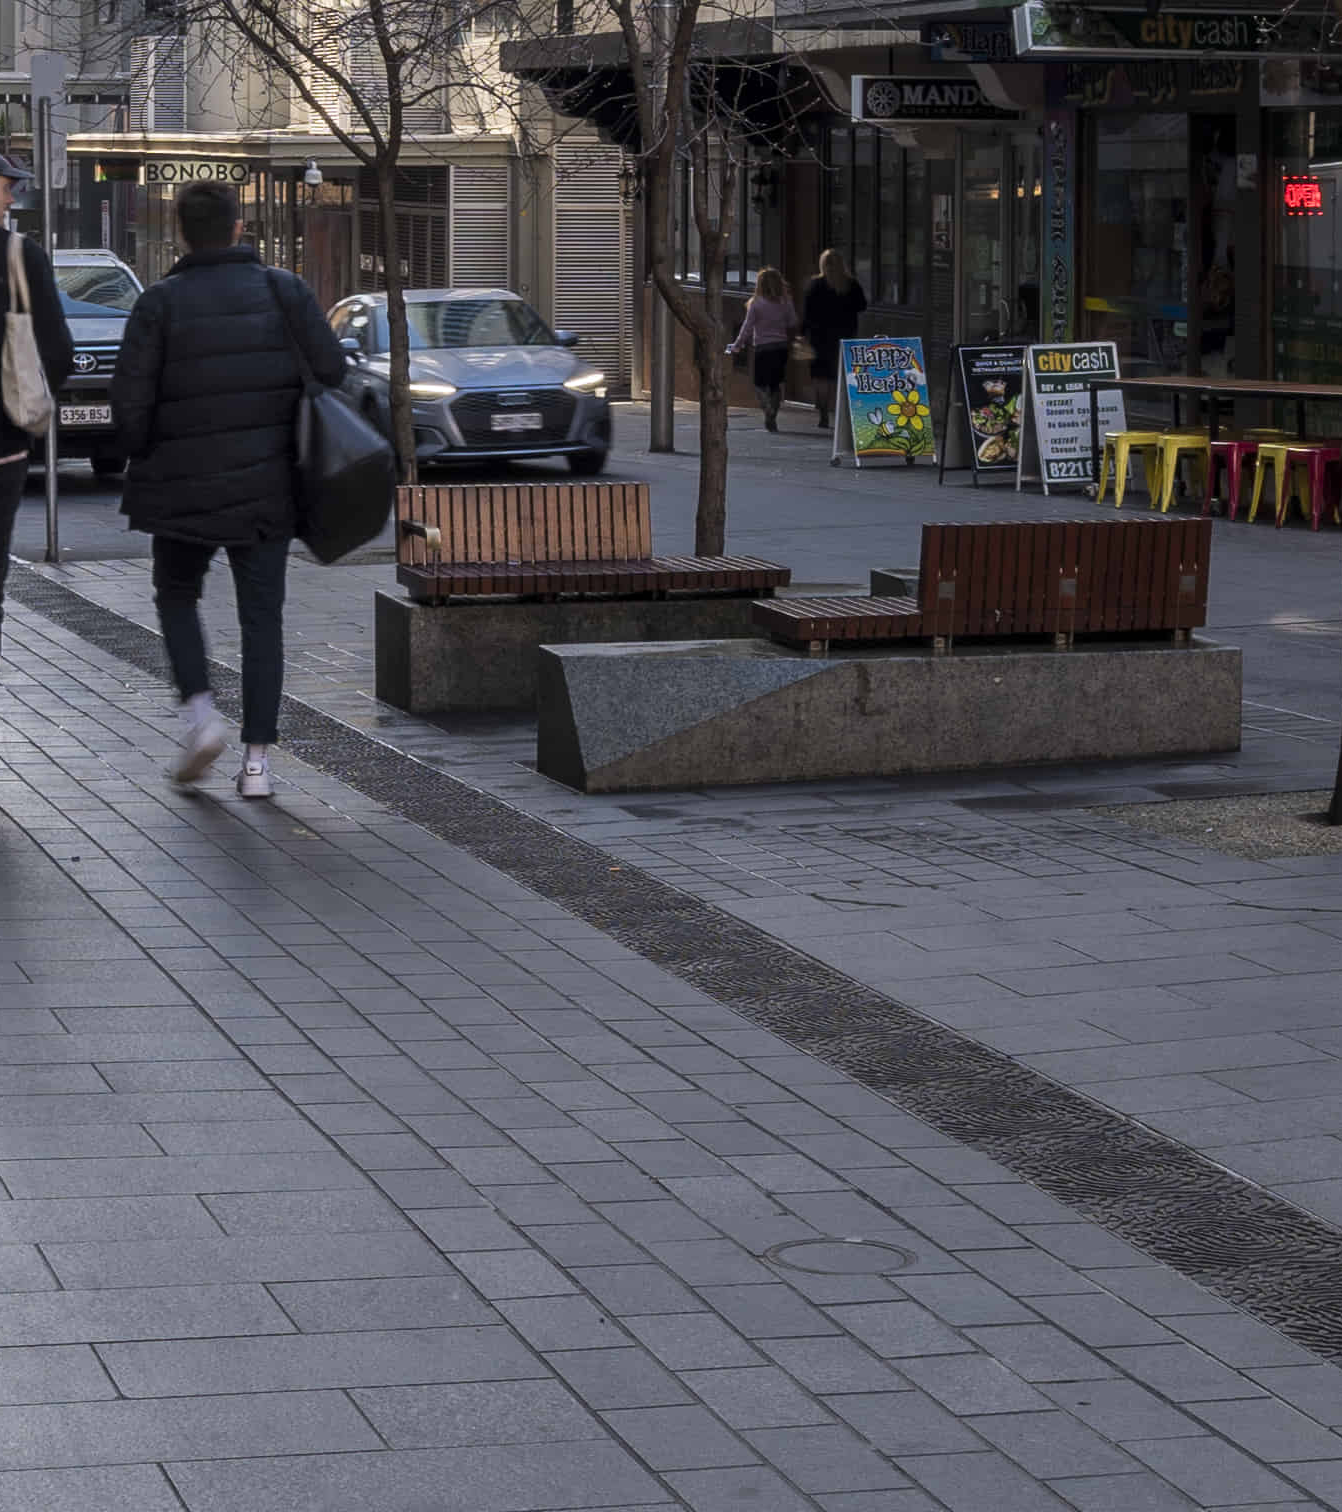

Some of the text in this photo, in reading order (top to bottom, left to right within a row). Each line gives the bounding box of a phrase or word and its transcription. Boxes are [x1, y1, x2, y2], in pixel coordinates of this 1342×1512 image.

[147, 164, 247, 181] BONOBO
[1284, 184, 1321, 207] OPEN
[851, 345, 914, 369] Happy
[857, 372, 916, 393] Herbs
[1050, 461, 1084, 477] 8221
